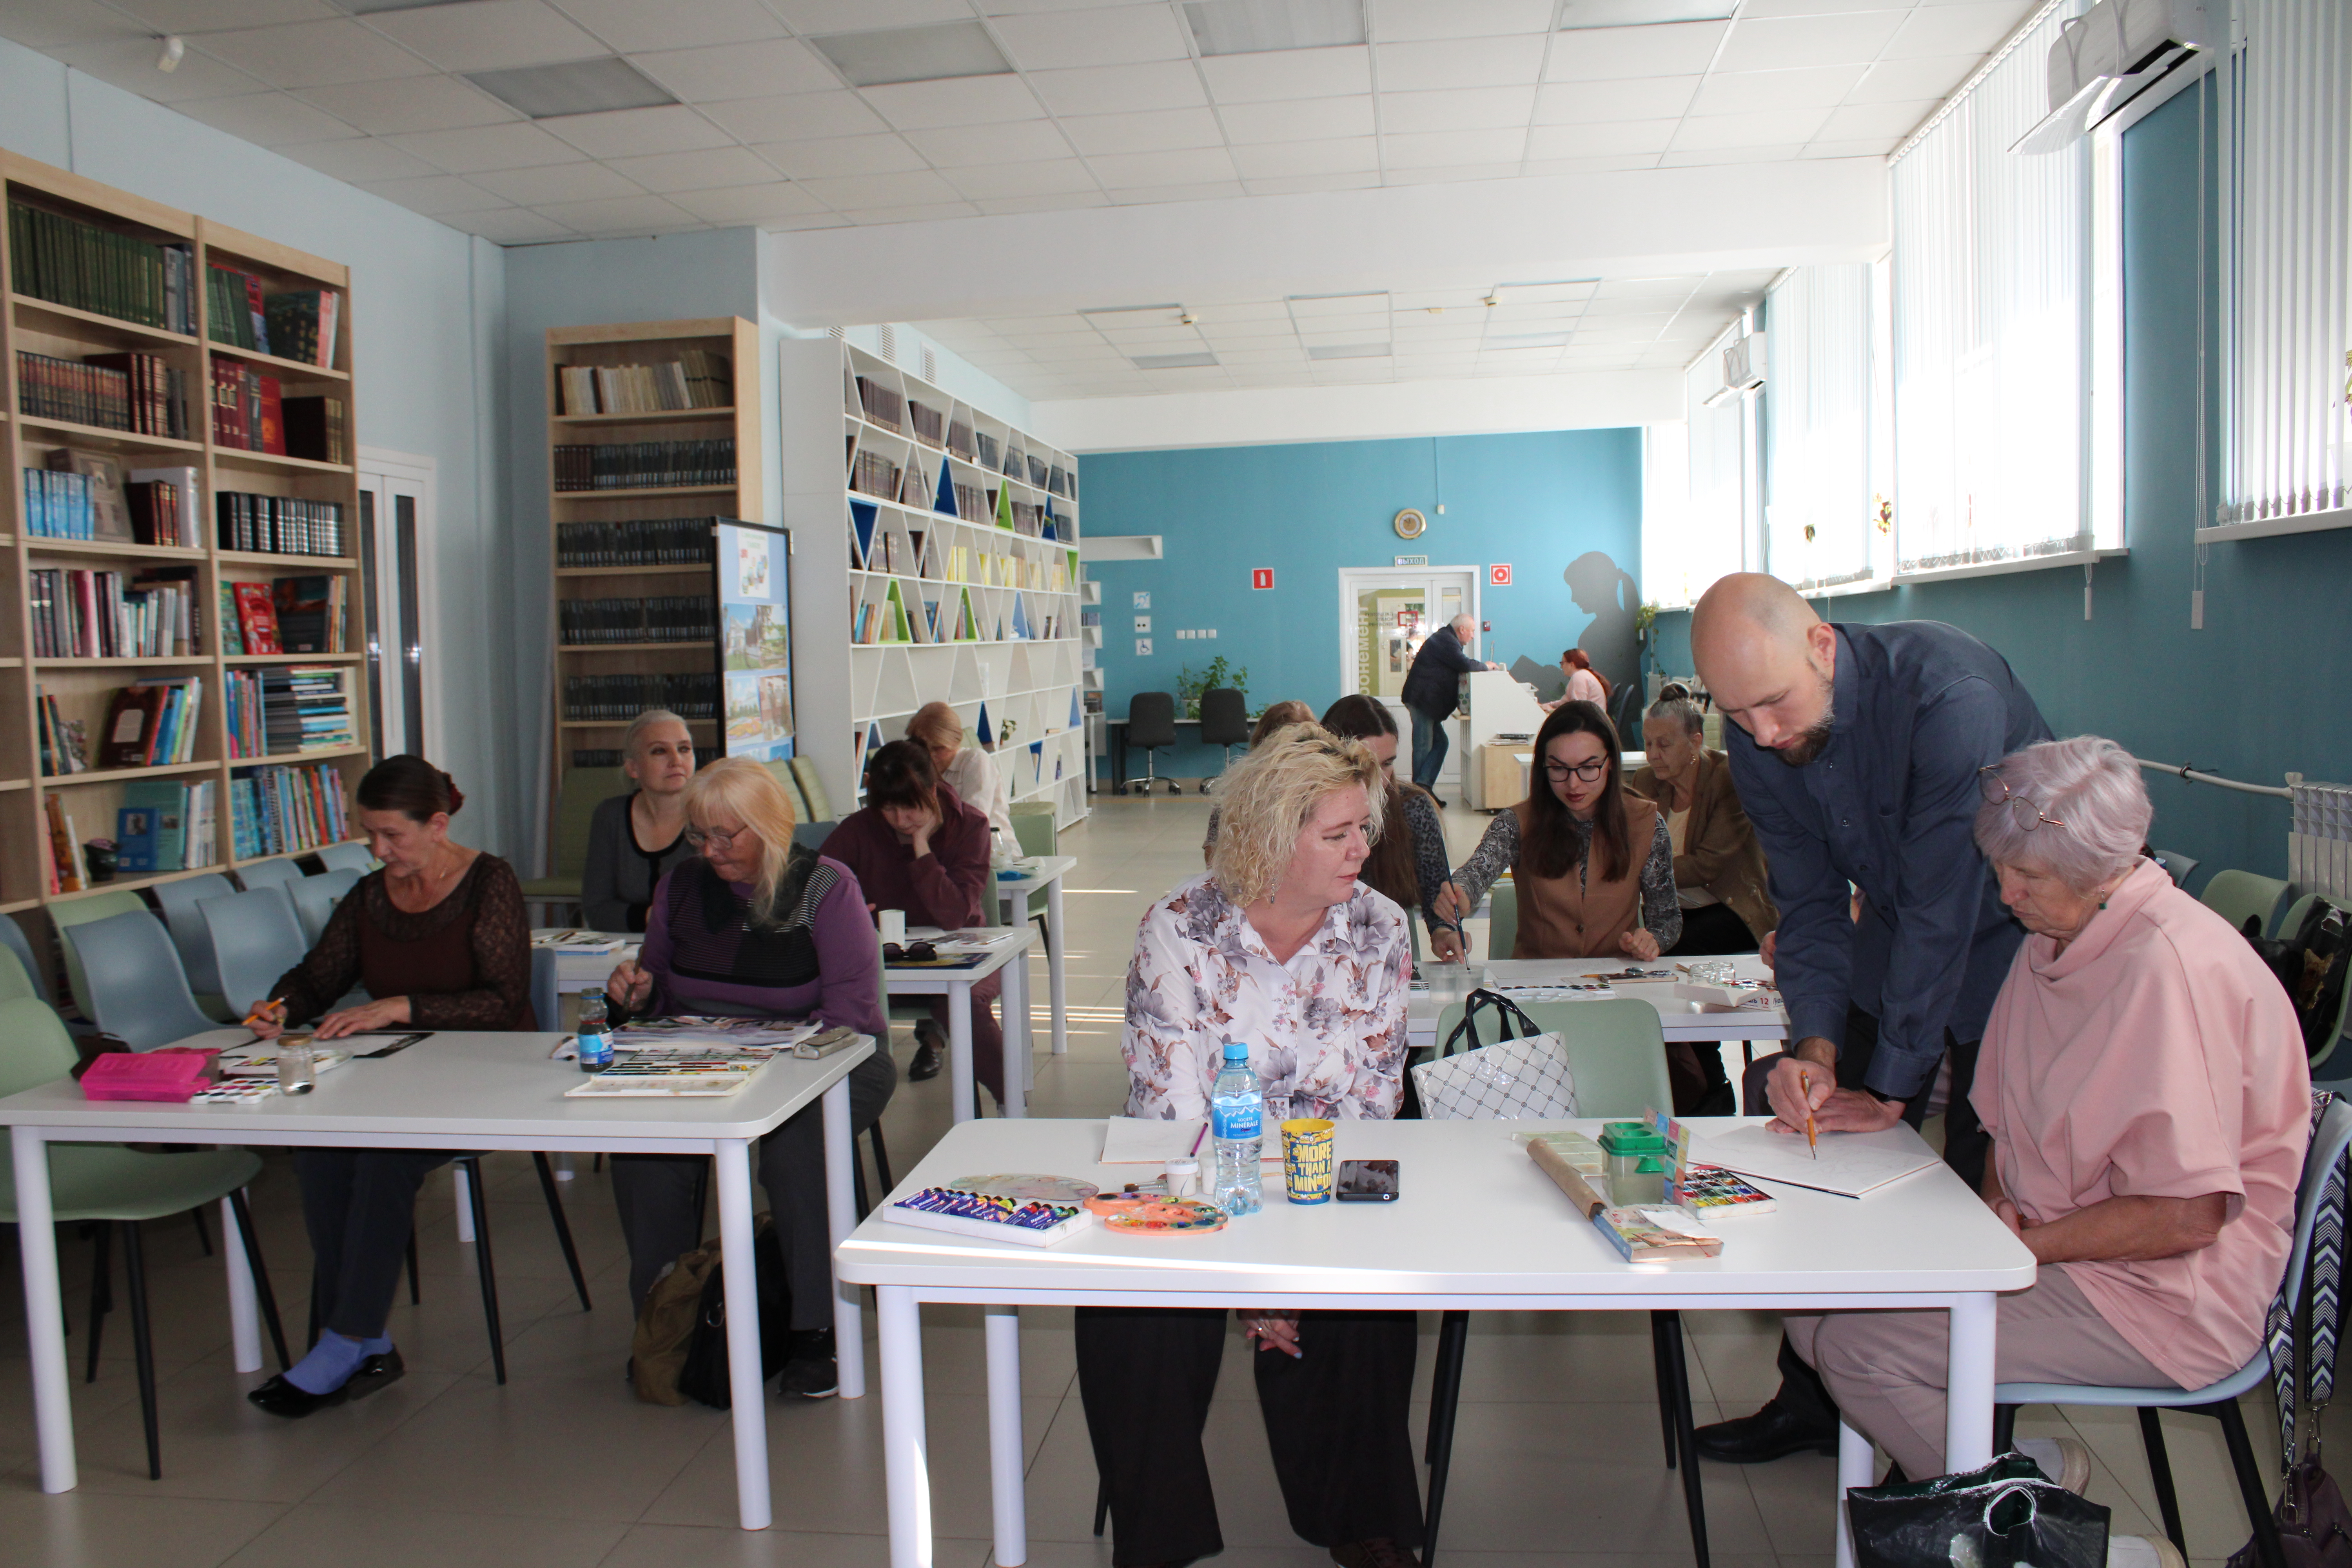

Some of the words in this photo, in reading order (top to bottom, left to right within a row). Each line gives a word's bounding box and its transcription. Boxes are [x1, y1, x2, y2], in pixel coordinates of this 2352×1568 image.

[1230, 1120, 1258, 1128] MINÉRALE
[1296, 1140, 1332, 1162] MORE
[1298, 1160, 1325, 1177] THAN
[1327, 1160, 1331, 1173] A
